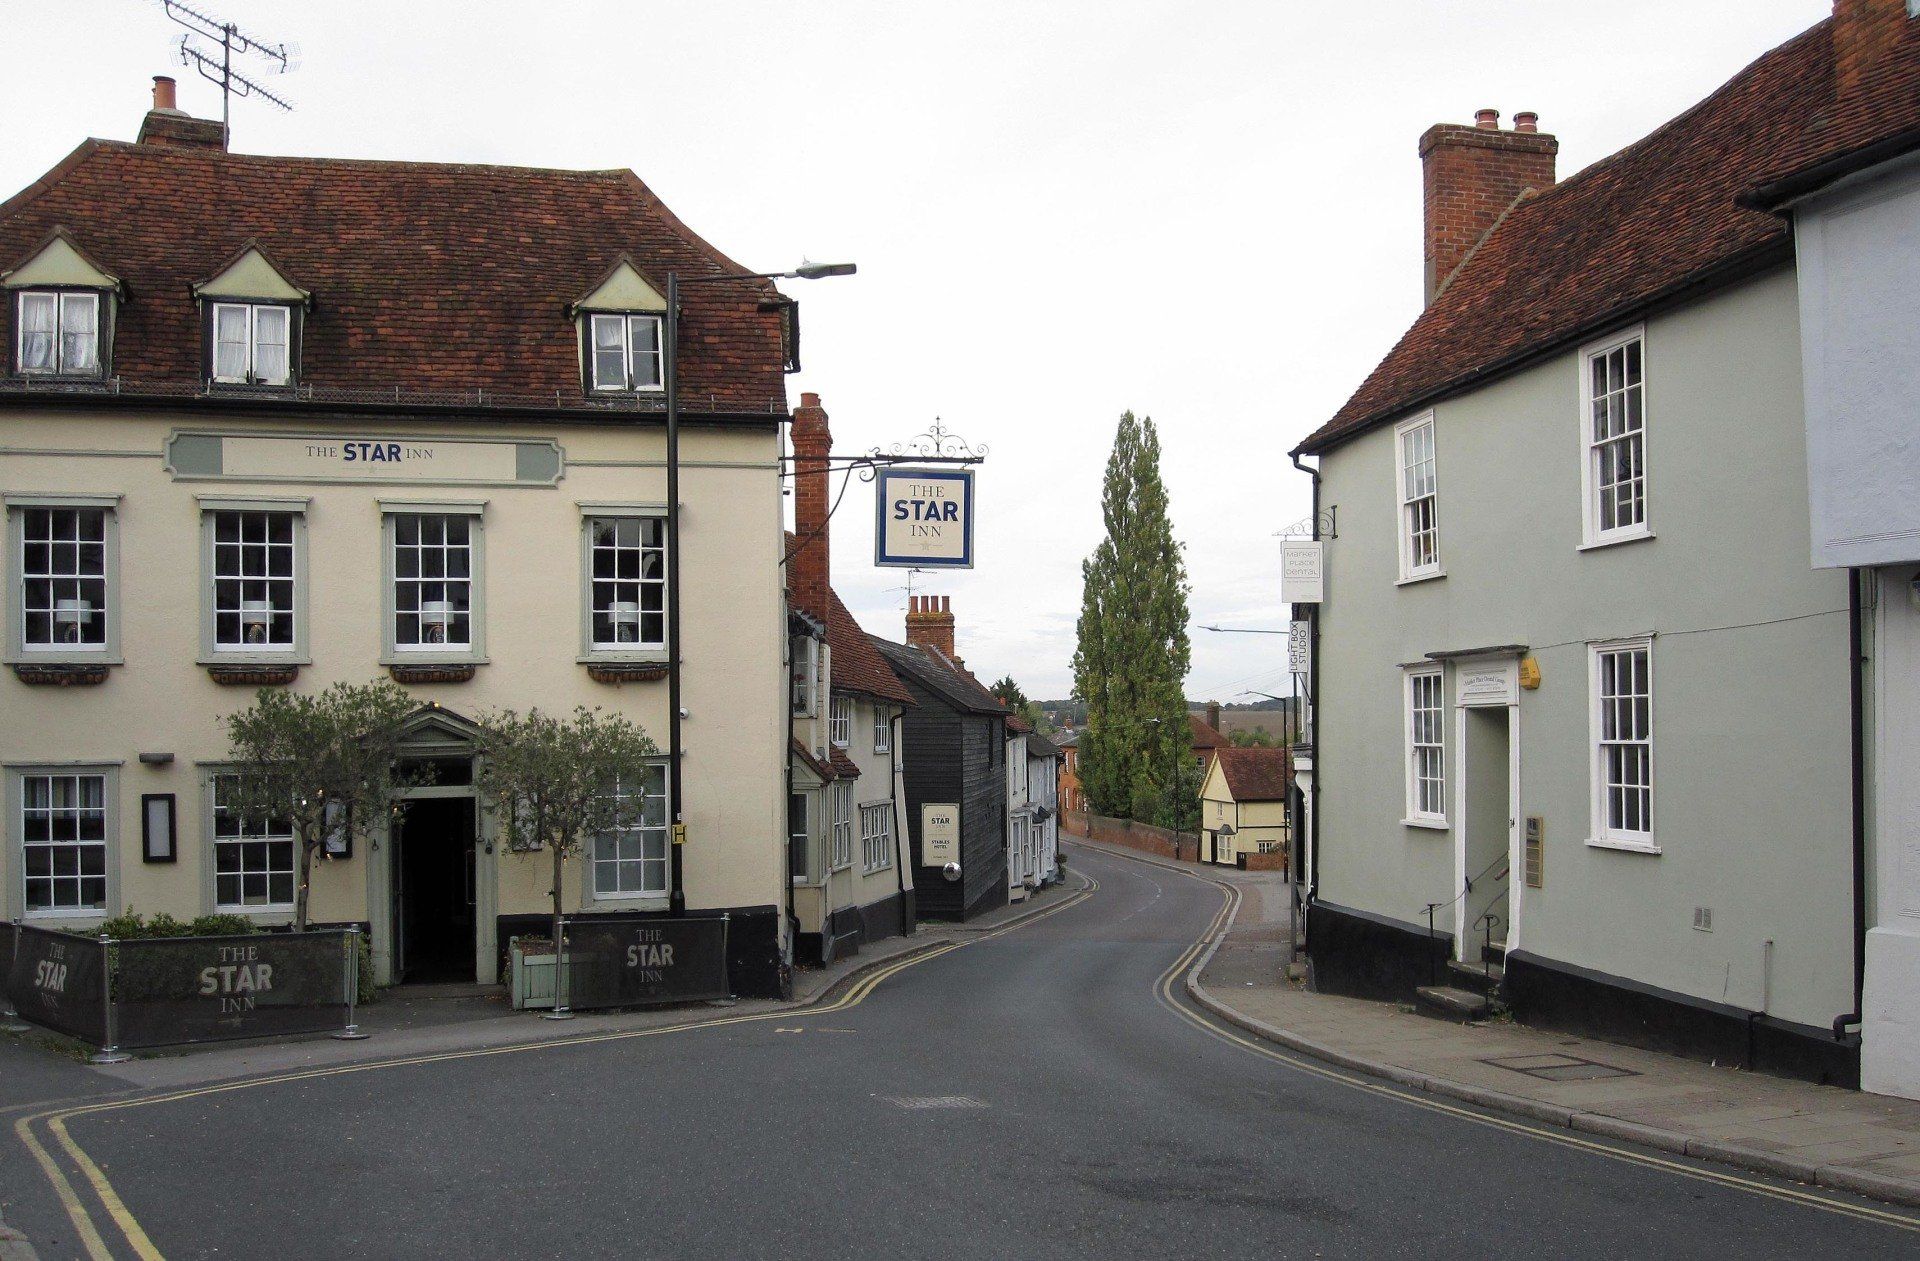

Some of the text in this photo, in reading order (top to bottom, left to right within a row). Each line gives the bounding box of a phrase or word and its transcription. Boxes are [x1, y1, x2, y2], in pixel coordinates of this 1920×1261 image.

[306, 443, 434, 462] THE STAR INN
[909, 484, 945, 498] THE
[893, 499, 958, 522] STAR
[910, 525, 942, 538] INN
[1290, 622, 1299, 671] LIGHT BOX
[1298, 630, 1307, 664] STUDIO
[674, 826, 686, 842] H
[635, 929, 663, 942] THE
[49, 942, 66, 960] THE
[218, 946, 259, 962] THE
[626, 944, 674, 967] STAR
[35, 960, 67, 992] STAR
[198, 964, 273, 995] STAR
[640, 970, 663, 983] INN
[221, 996, 256, 1013] INN
